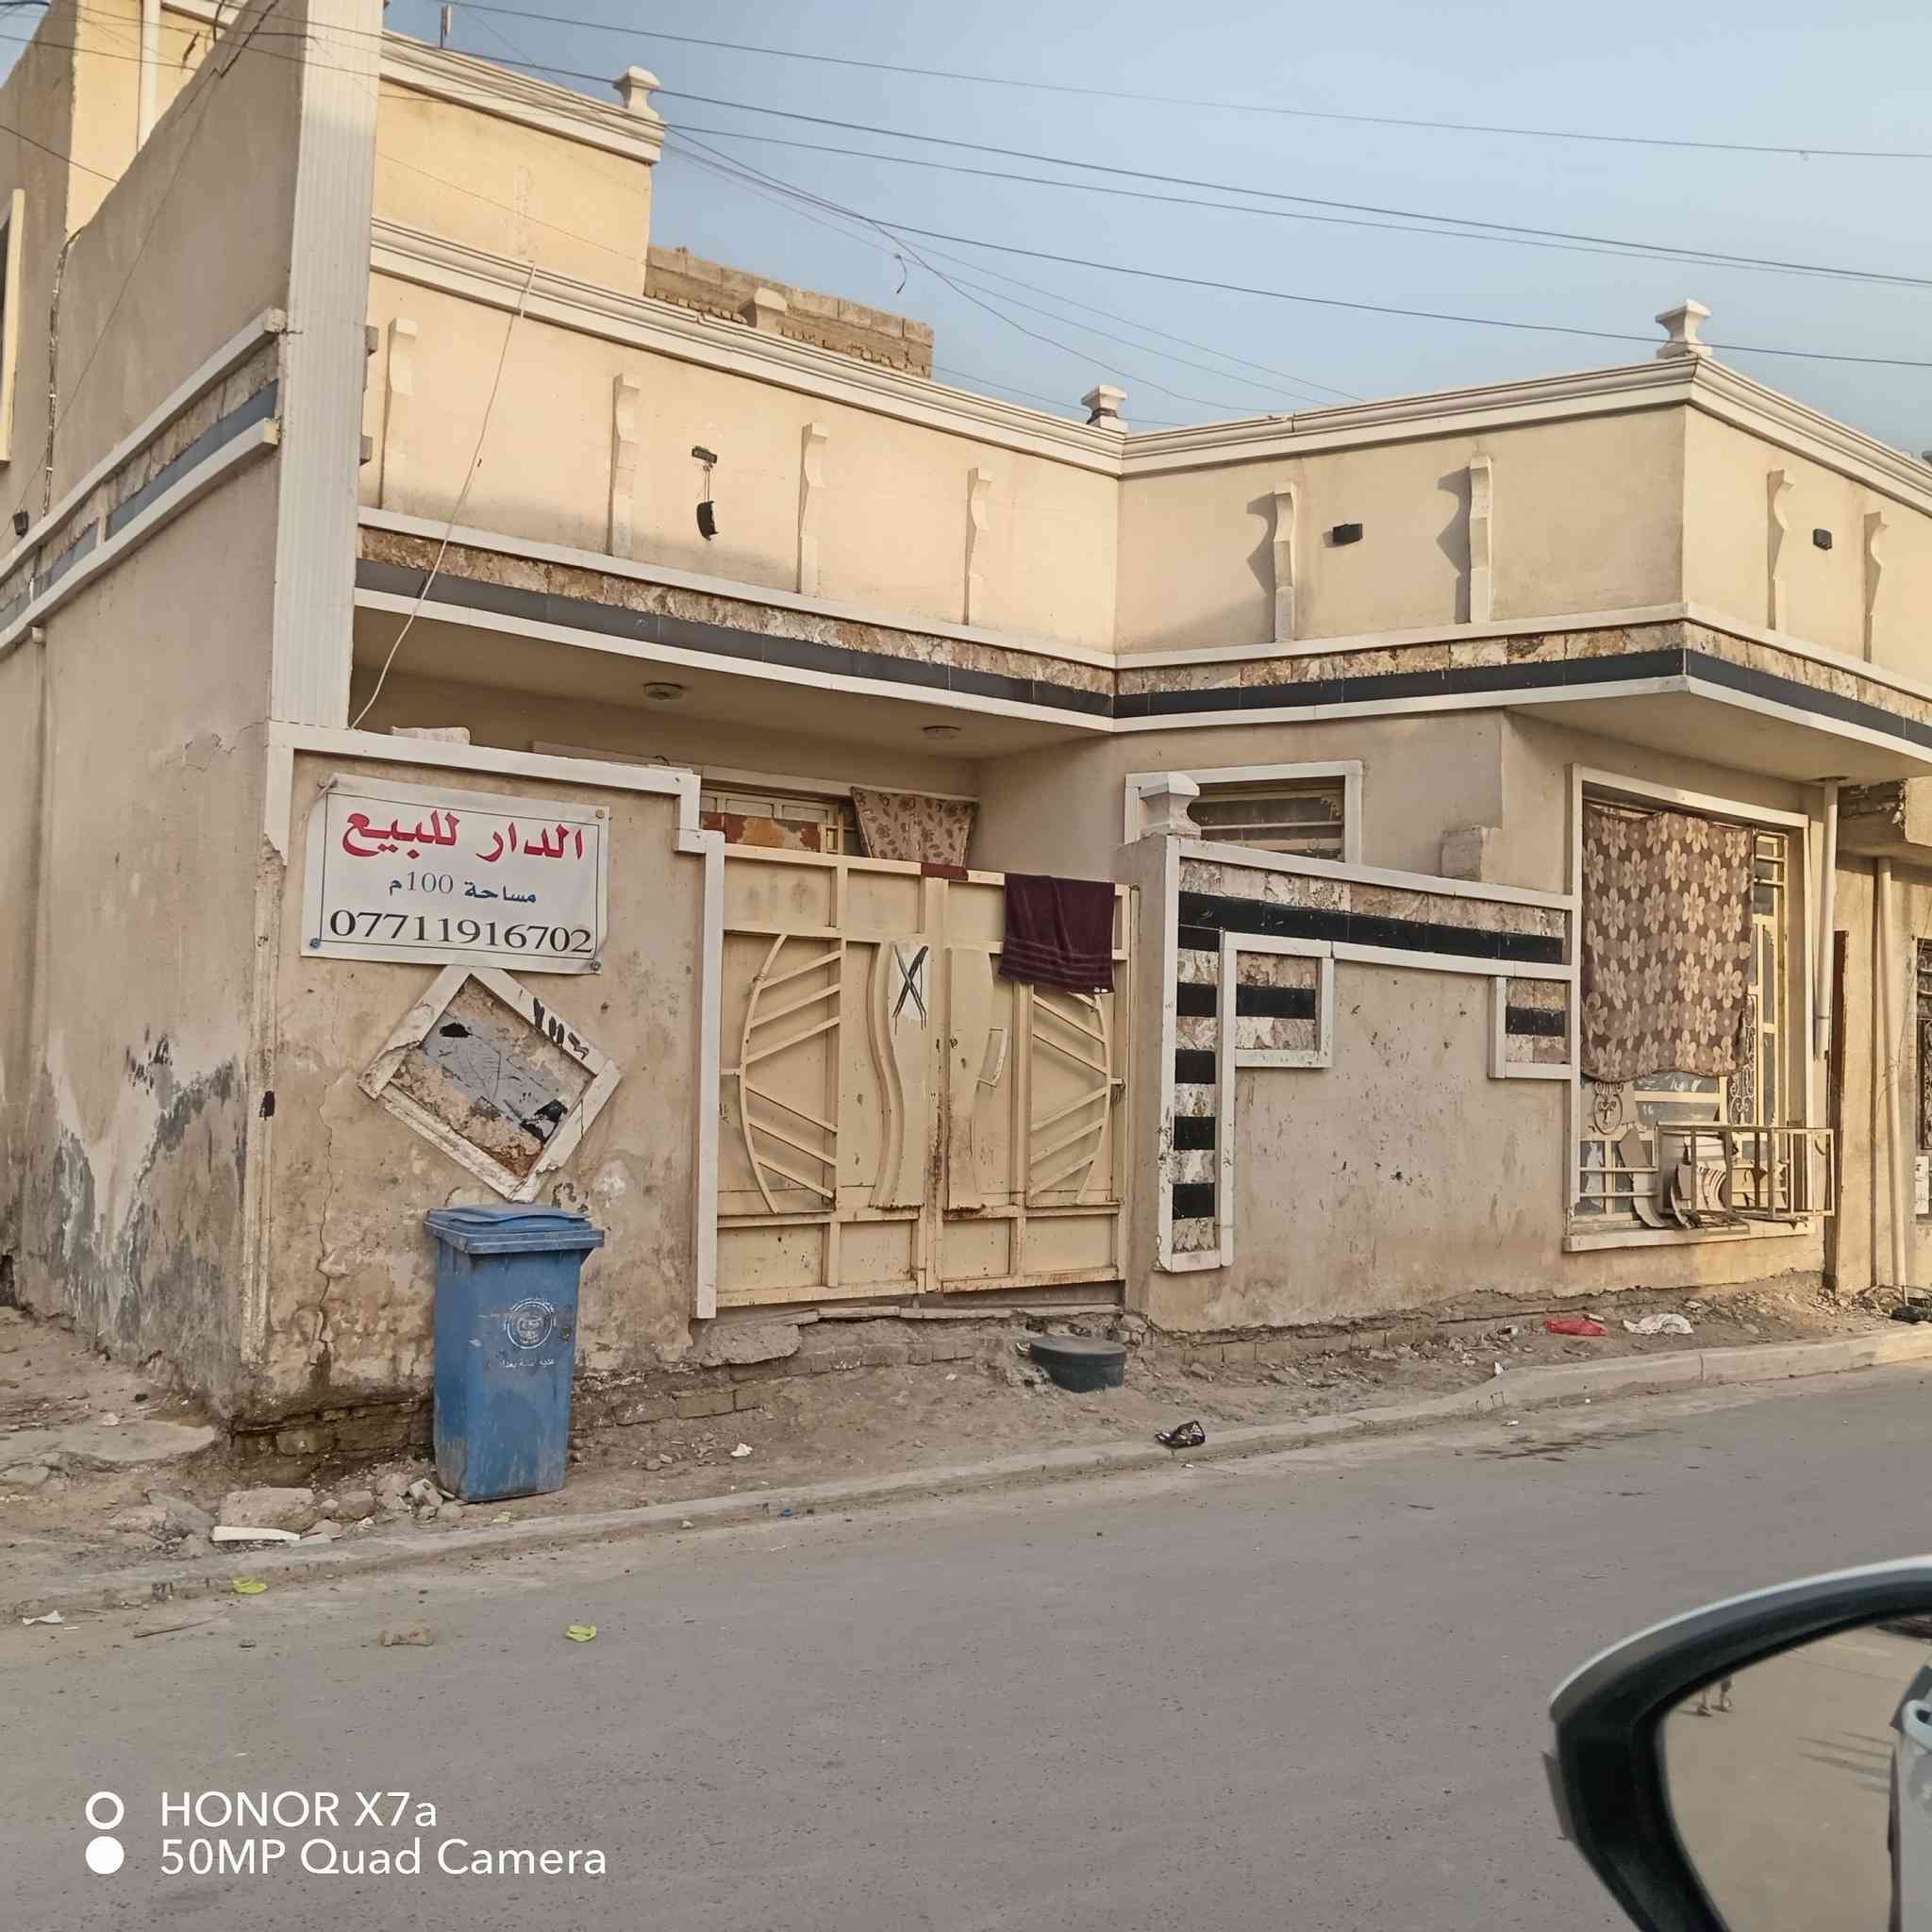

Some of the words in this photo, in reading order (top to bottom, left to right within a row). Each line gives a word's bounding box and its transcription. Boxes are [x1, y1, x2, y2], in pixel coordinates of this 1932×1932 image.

[341, 808, 461, 859] للبيع
[475, 822, 584, 862] الدار
[463, 879, 538, 904] مساحة
[329, 908, 593, 954] 07711916702
